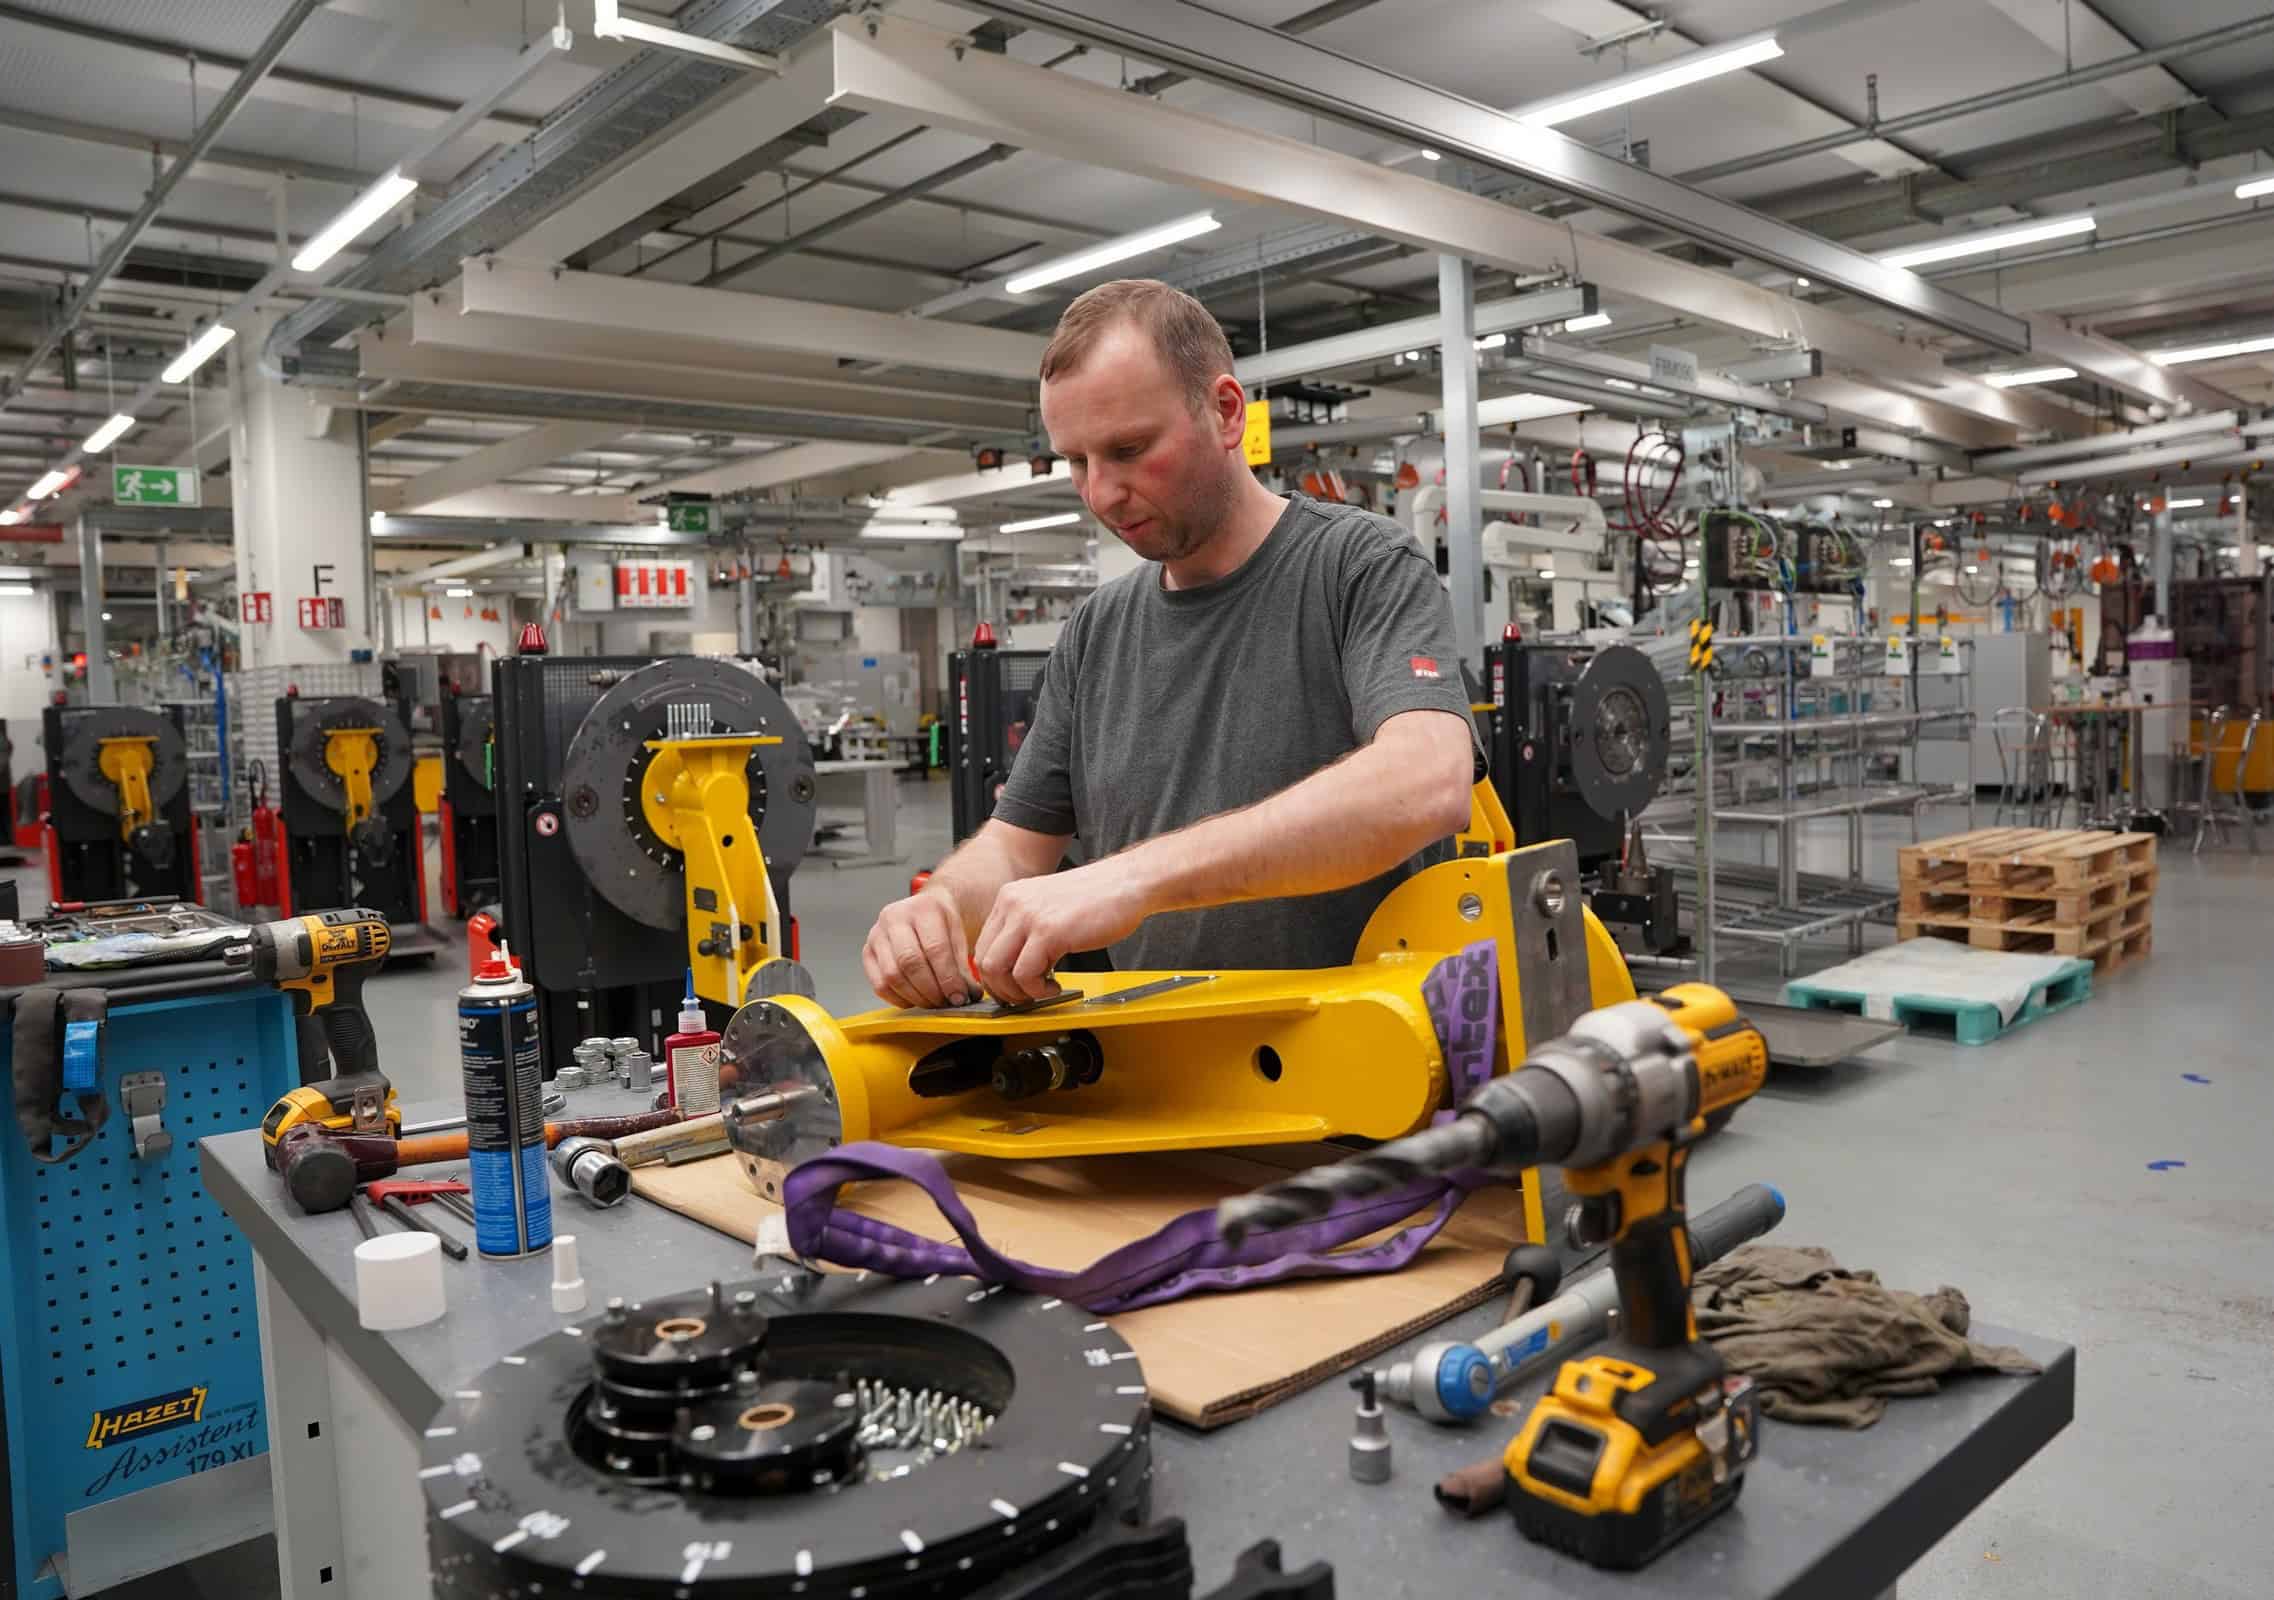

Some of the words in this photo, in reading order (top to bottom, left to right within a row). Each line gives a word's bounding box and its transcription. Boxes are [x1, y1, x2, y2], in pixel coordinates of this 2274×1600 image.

[313, 564, 335, 597] F
[100, 1396, 197, 1440] HAZET
[85, 1407, 258, 1497] Assistent
[186, 1449, 226, 1475] 179
